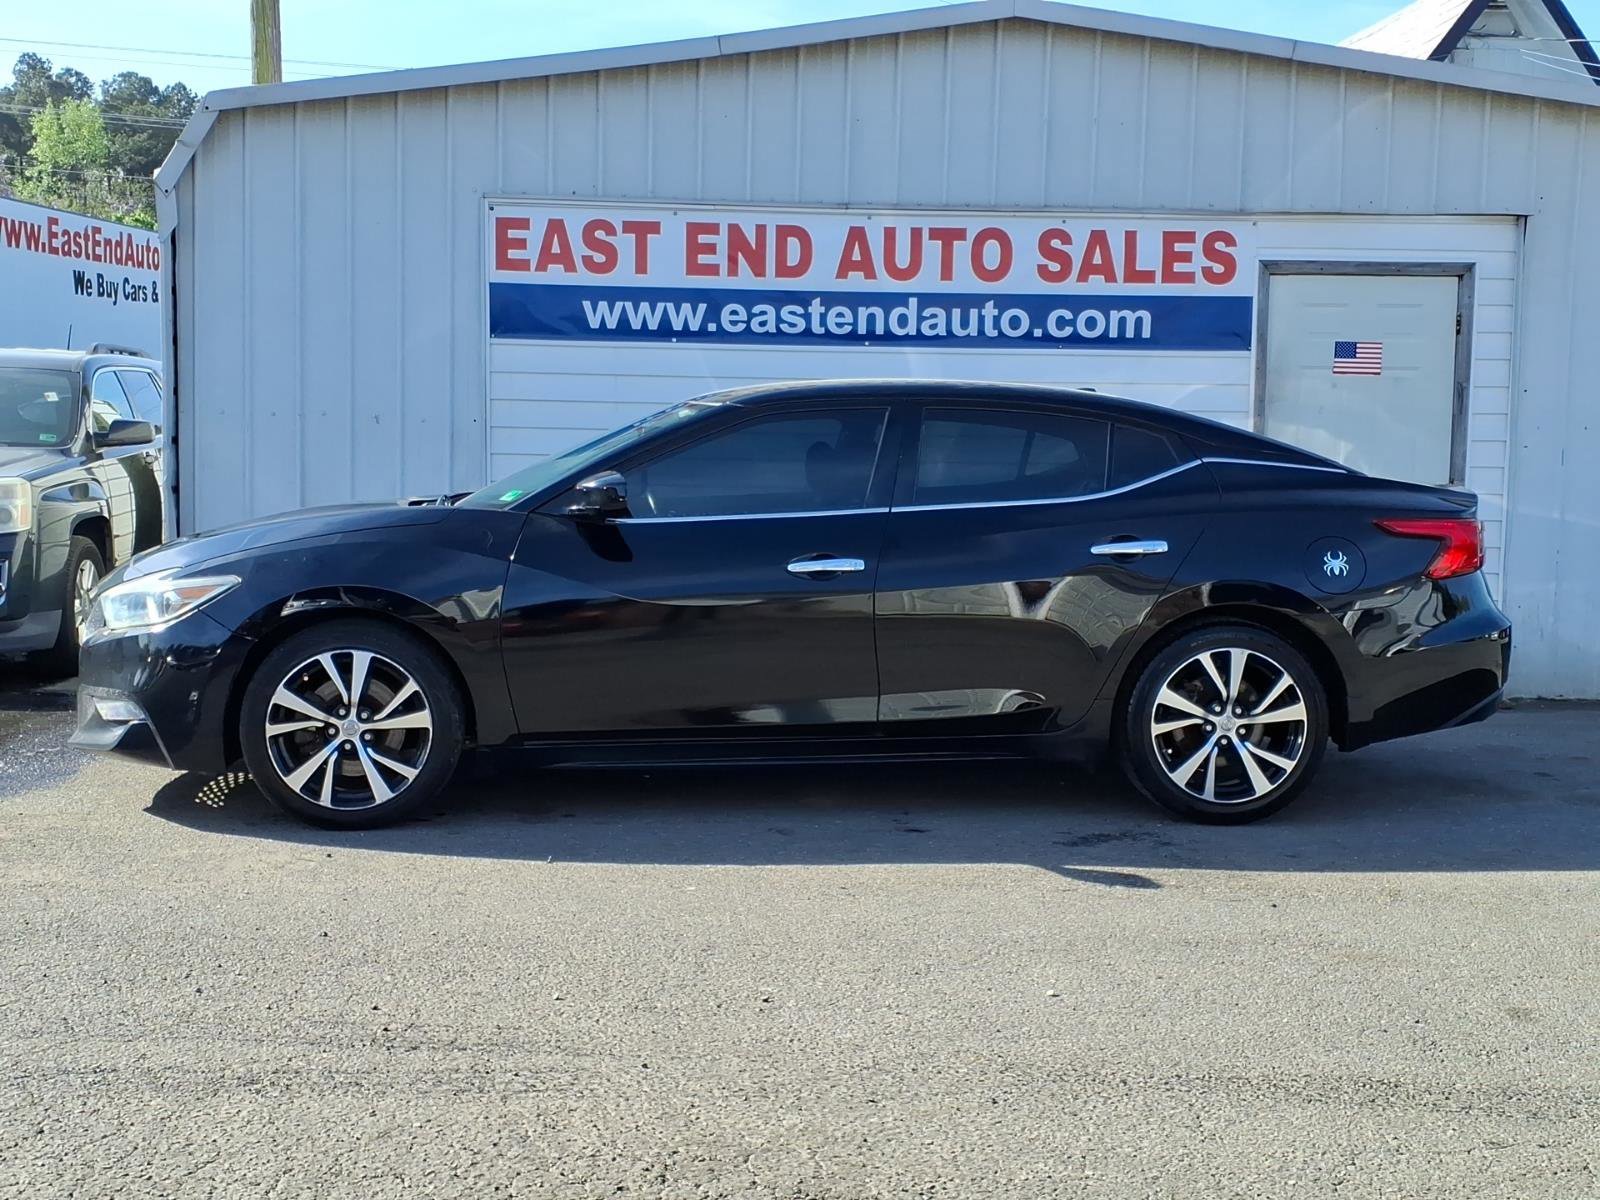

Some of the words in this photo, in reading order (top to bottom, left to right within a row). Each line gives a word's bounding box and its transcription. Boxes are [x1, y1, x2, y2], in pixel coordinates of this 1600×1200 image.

[0, 215, 160, 271] ww.EastEndAuto
[494, 216, 661, 275] EAST
[685, 221, 813, 279] END
[835, 226, 1014, 283] AUTO
[1036, 227, 1238, 285] SALES
[73, 269, 93, 297] We
[97, 273, 119, 306] Buy
[122, 277, 148, 302] Cars
[151, 281, 159, 303] &
[582, 296, 1152, 339] www.eastendauto.com
